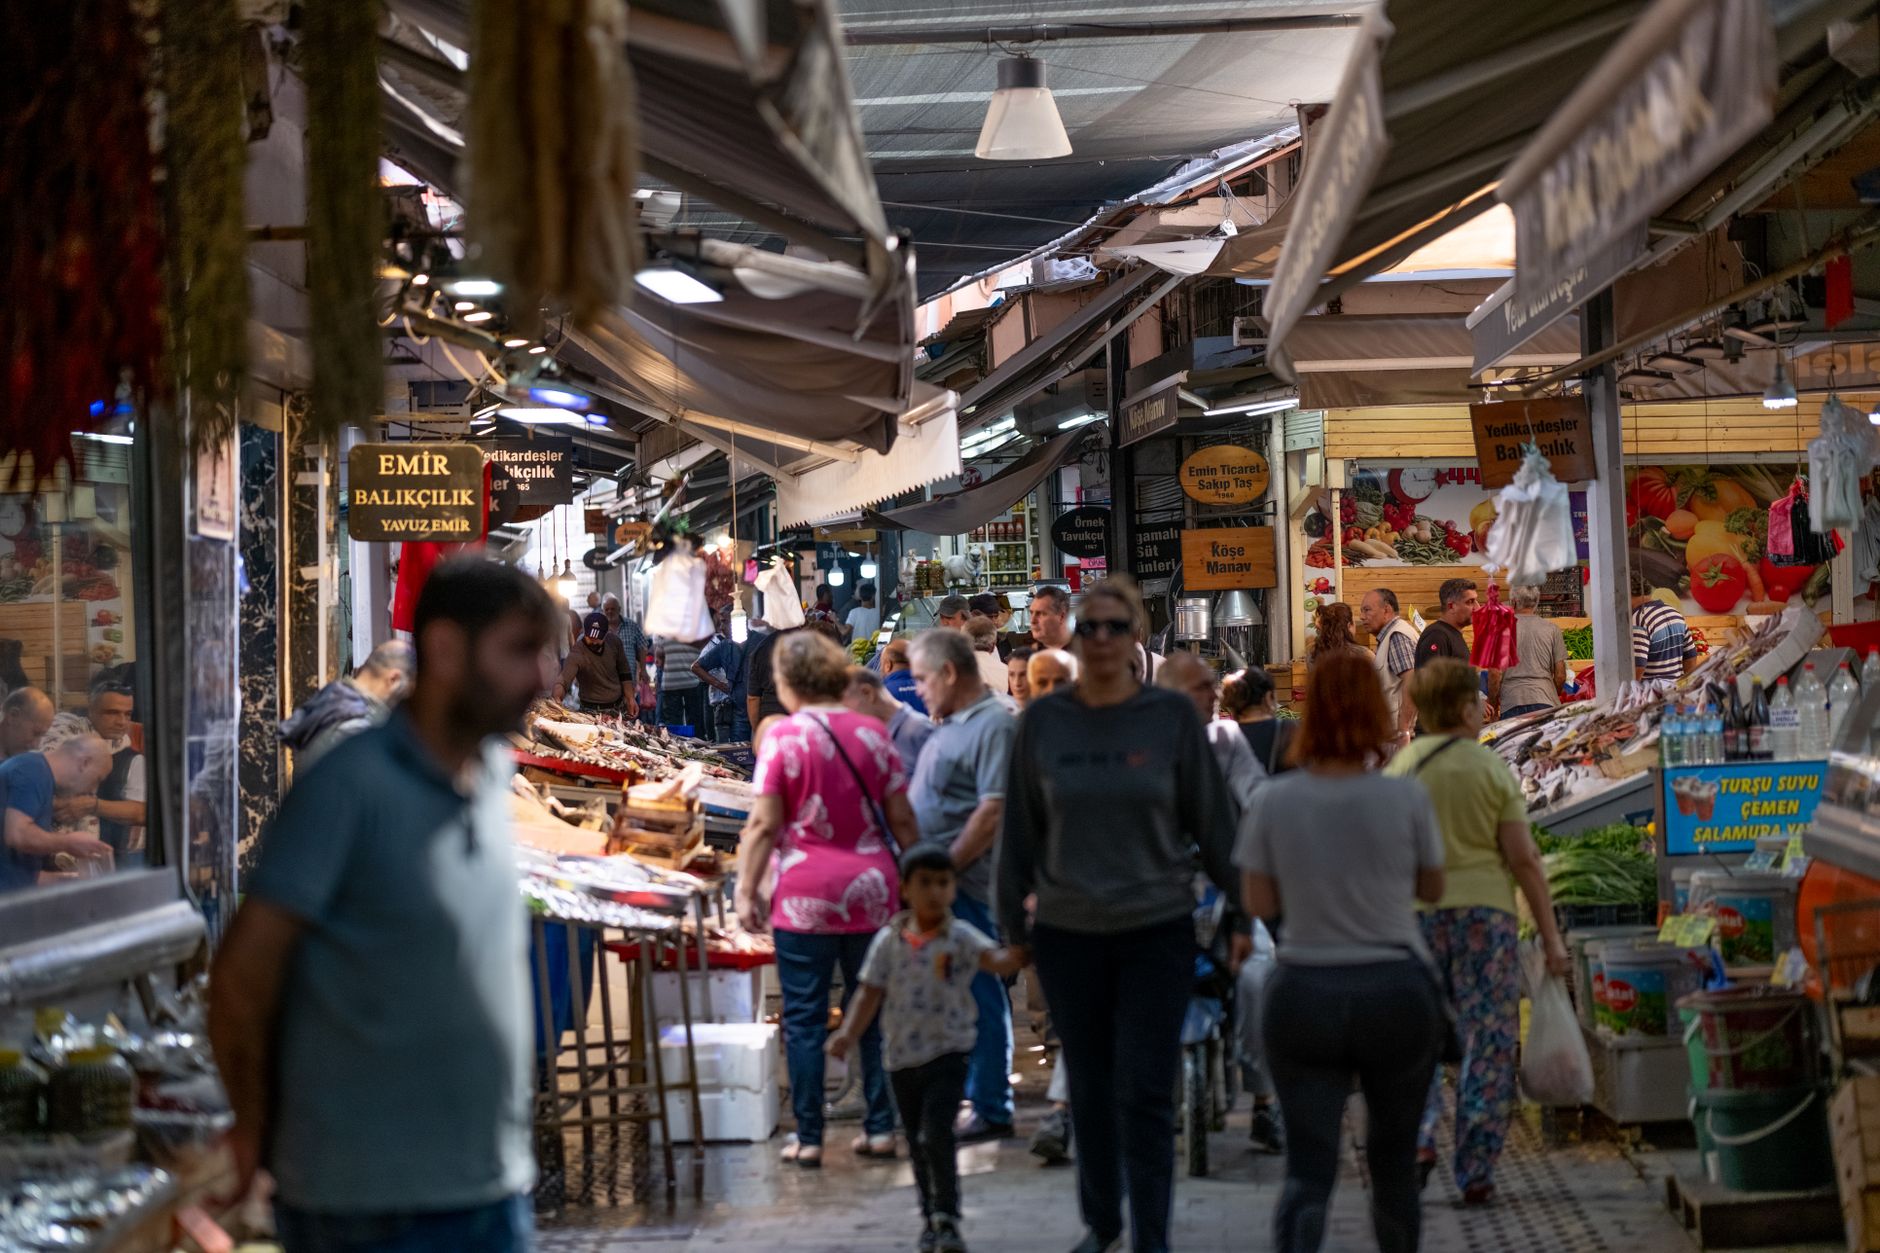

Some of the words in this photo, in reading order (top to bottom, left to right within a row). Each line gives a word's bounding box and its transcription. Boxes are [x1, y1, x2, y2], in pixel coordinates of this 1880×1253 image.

[1484, 418, 1578, 439] Yedikardeşler
[378, 450, 451, 475] EMİR
[481, 449, 564, 464] edikardeşler
[1188, 465, 1217, 477] Emin
[1219, 463, 1261, 476] Ticaret
[1198, 479, 1231, 491] Sakıp
[1233, 477, 1253, 491] Taş
[354, 488, 476, 509] BALIKÇILIK
[381, 518, 430, 532] YAVUZ
[1075, 515, 1105, 528] Örnek
[1137, 545, 1159, 558] Süt
[1211, 543, 1245, 560] Köşe
[1206, 560, 1253, 575] Manav
[1721, 776, 1772, 796] TURŞU
[1778, 774, 1818, 791] SUYU
[1741, 799, 1800, 820] ÇEMEN
[1694, 824, 1781, 843] SALAMURA
